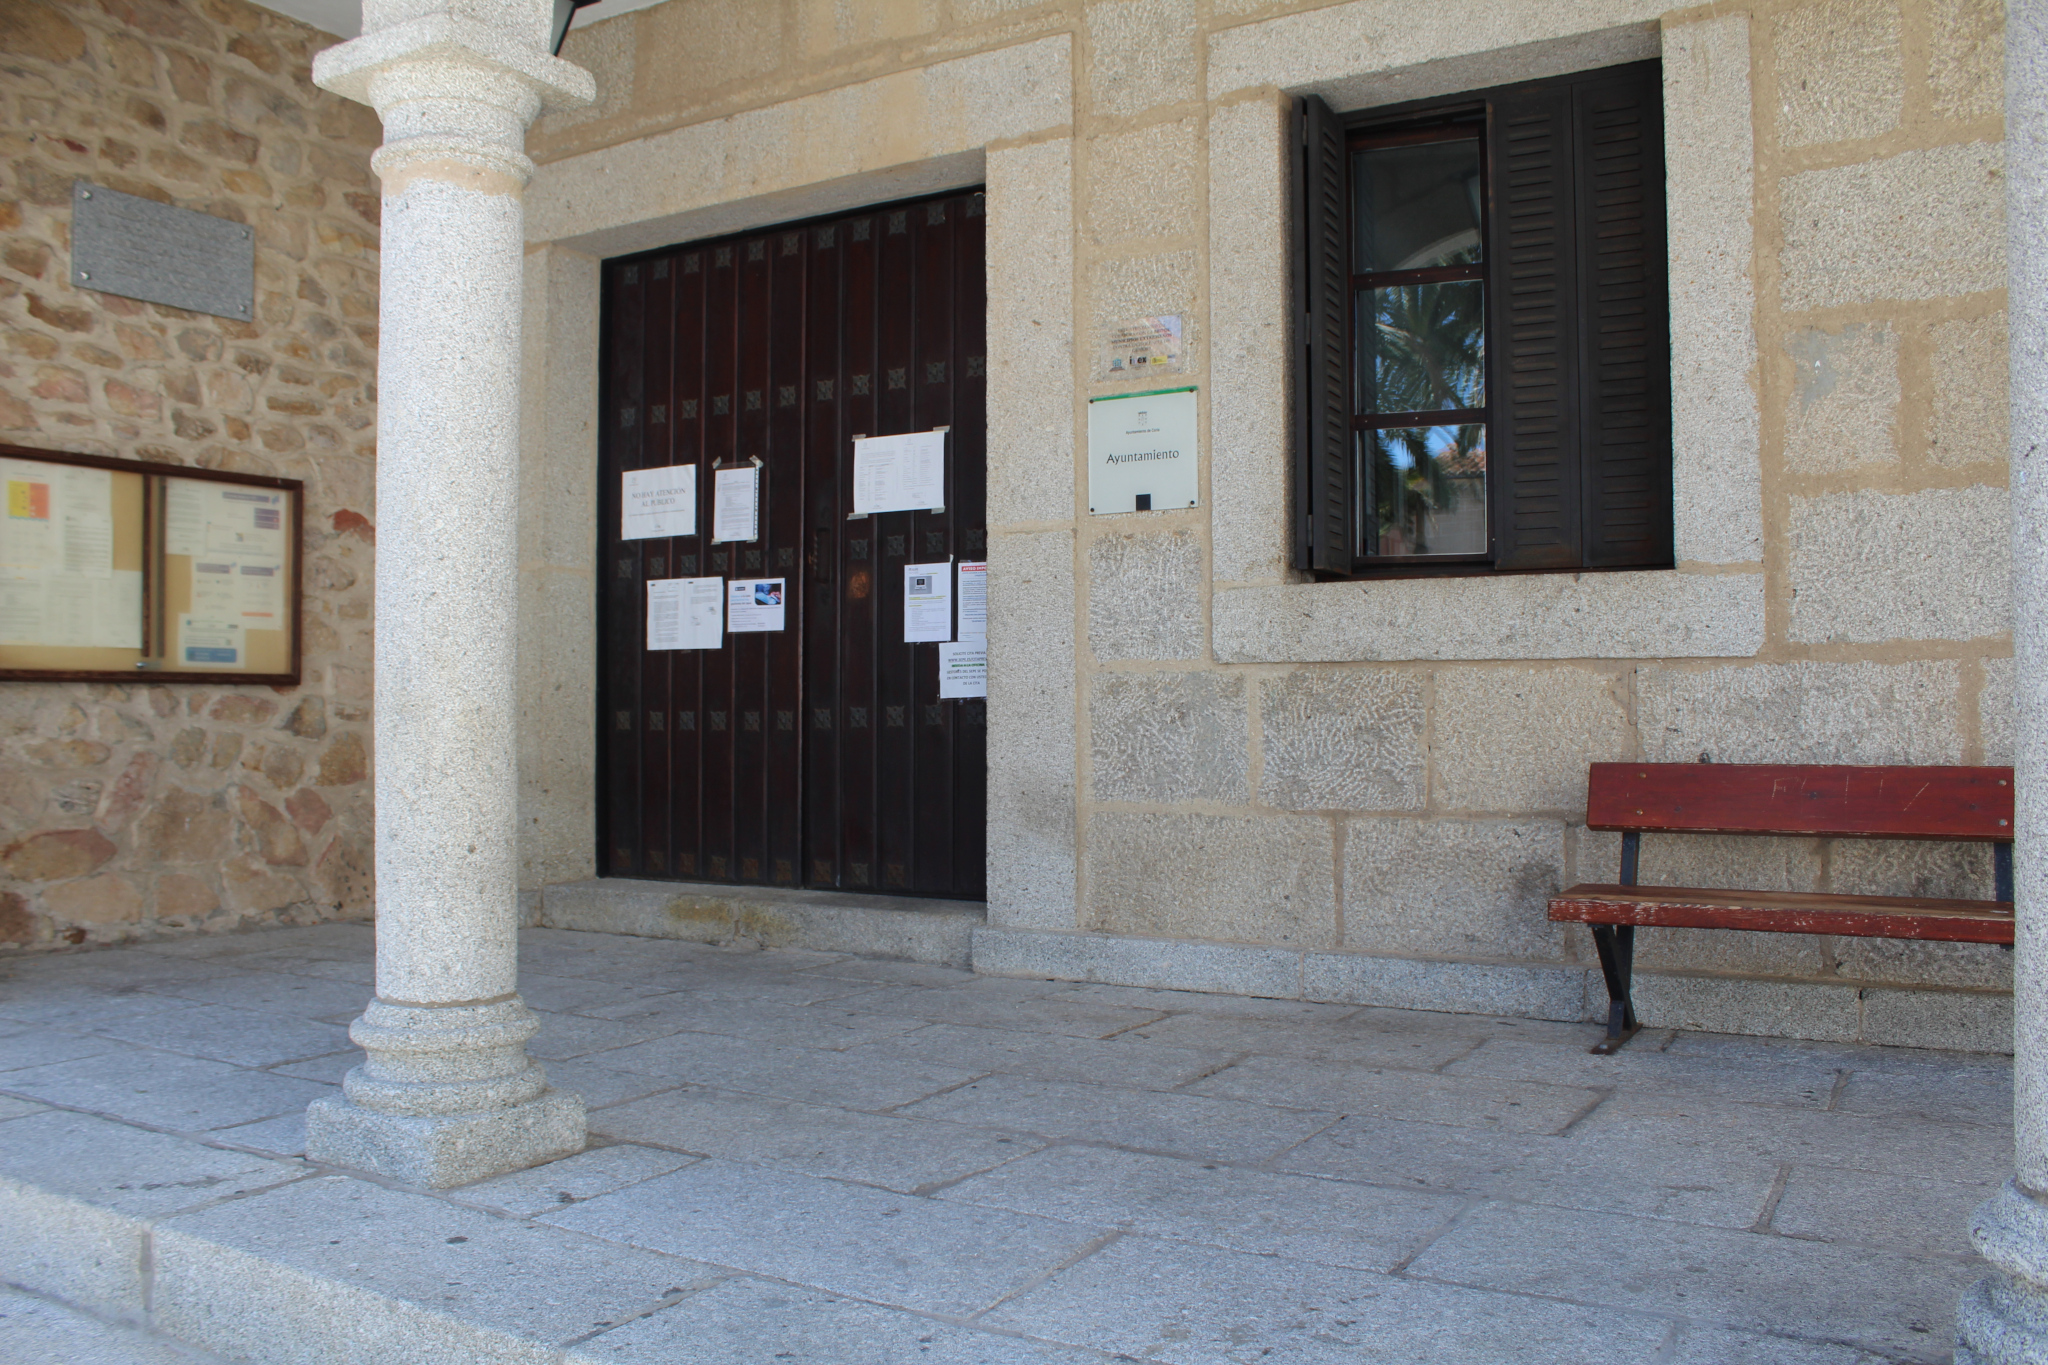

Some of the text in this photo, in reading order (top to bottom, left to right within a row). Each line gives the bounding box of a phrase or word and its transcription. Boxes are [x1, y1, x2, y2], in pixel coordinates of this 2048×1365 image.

[1106, 449, 1180, 466] Ayuntamiento
[632, 492, 641, 500] NO
[641, 490, 654, 499] HAY
